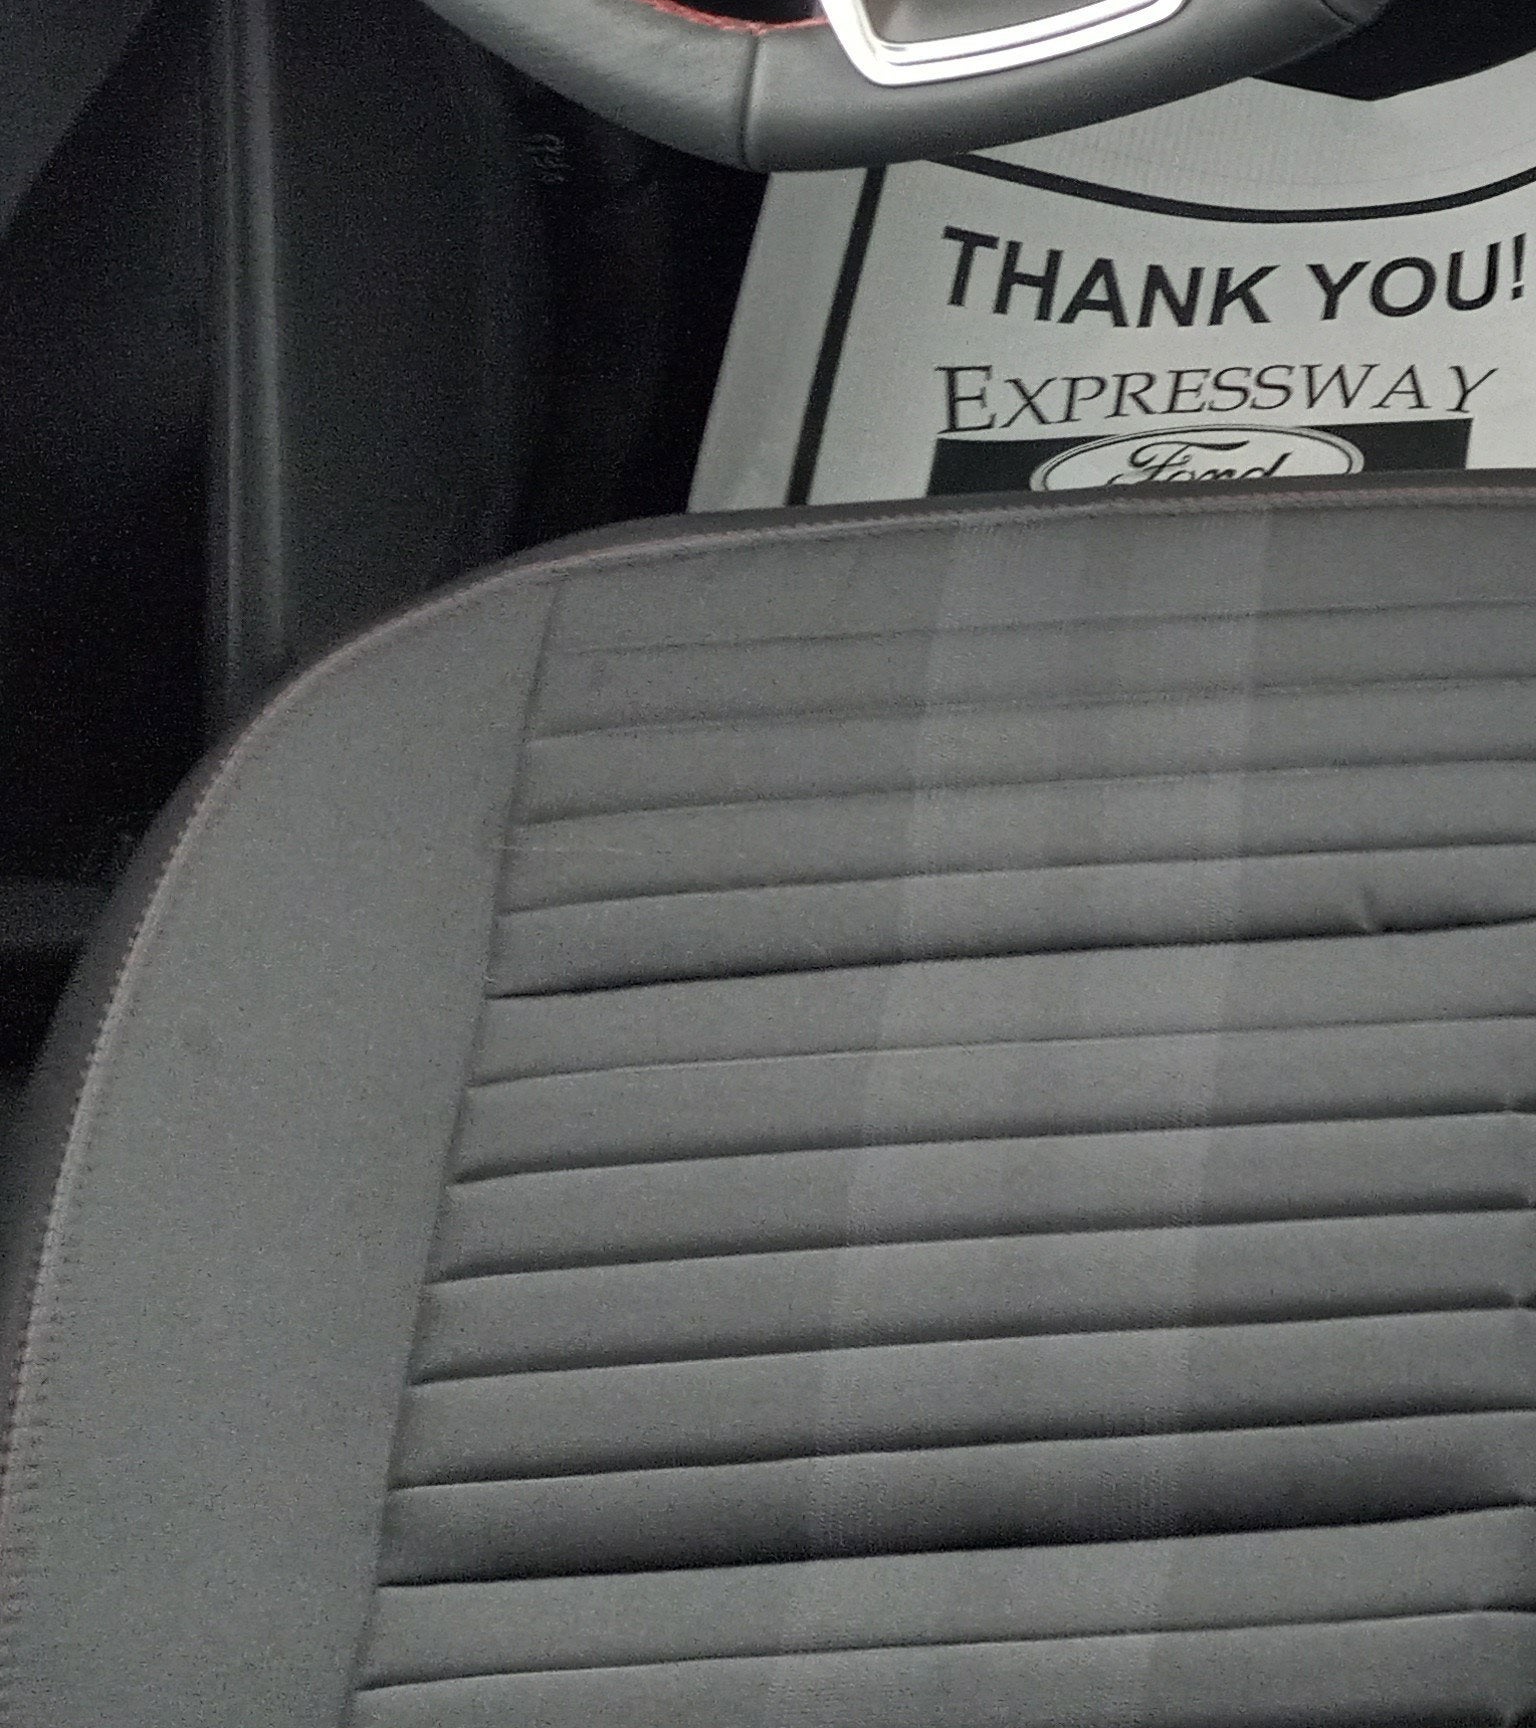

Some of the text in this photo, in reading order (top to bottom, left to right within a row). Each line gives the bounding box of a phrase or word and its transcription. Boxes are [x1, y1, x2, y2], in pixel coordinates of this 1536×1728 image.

[942, 225, 1528, 328] THANK YOU!
[934, 361, 1500, 434] EXPRESSWAY
